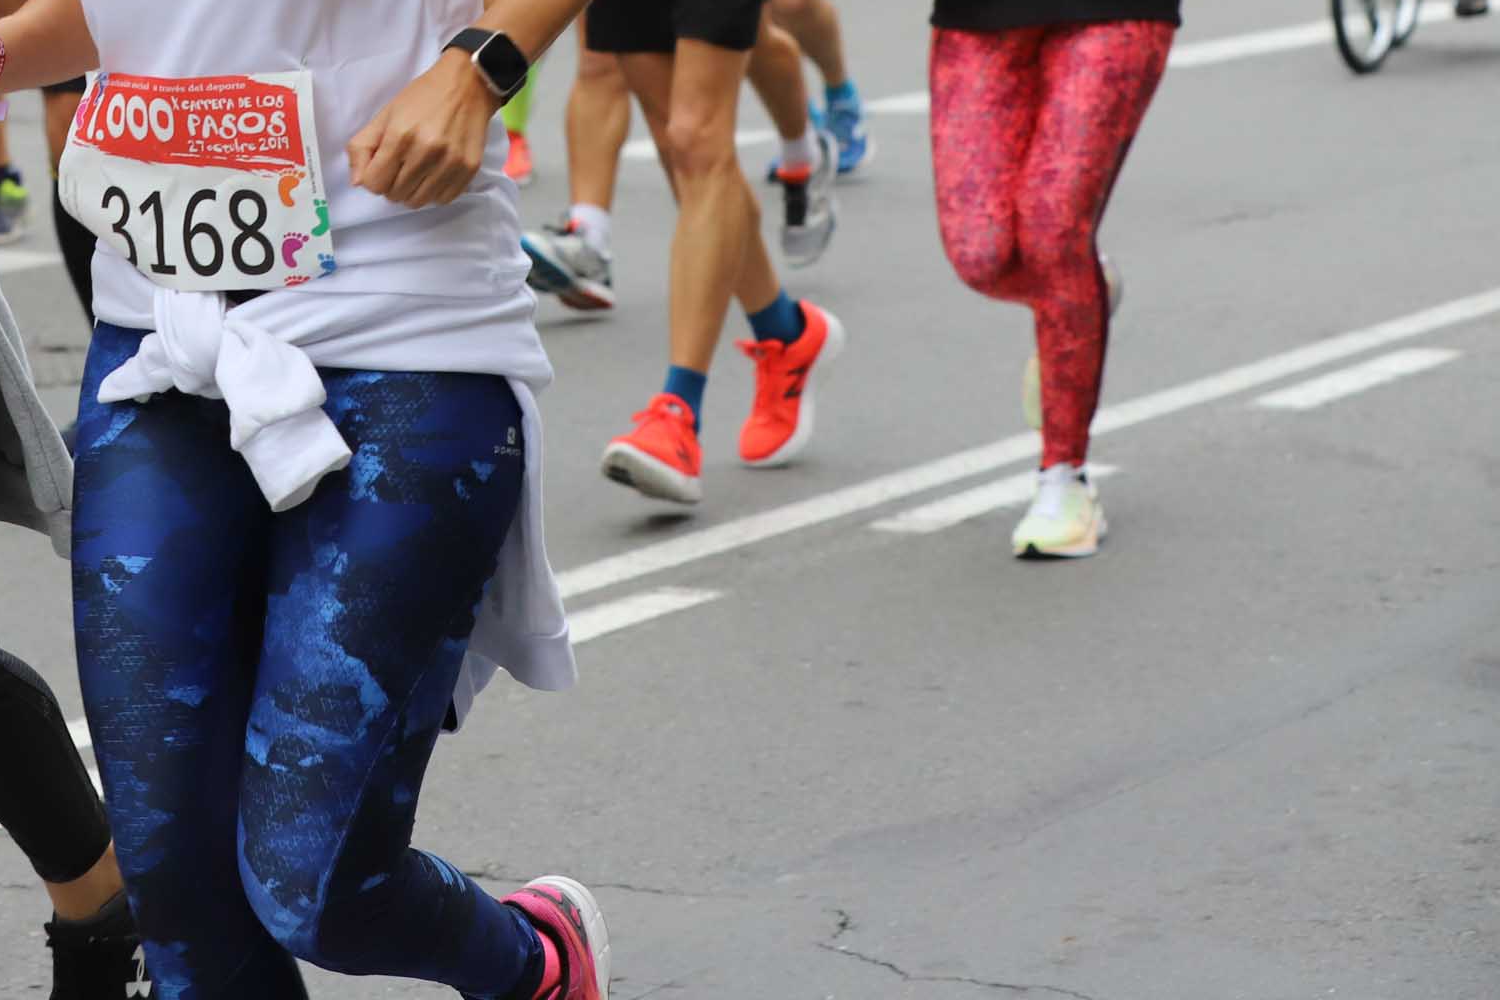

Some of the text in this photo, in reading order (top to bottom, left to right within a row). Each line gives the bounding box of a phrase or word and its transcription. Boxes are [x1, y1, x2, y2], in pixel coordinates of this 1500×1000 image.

[187, 83, 204, 93] del
[205, 81, 246, 93] deporte
[238, 95, 252, 108] DE
[256, 95, 284, 108] LOS
[86, 92, 175, 142] 1.000
[187, 111, 287, 139] PASOS
[188, 140, 204, 153] 27
[259, 136, 289, 151] 2019
[101, 186, 275, 276] 3168
